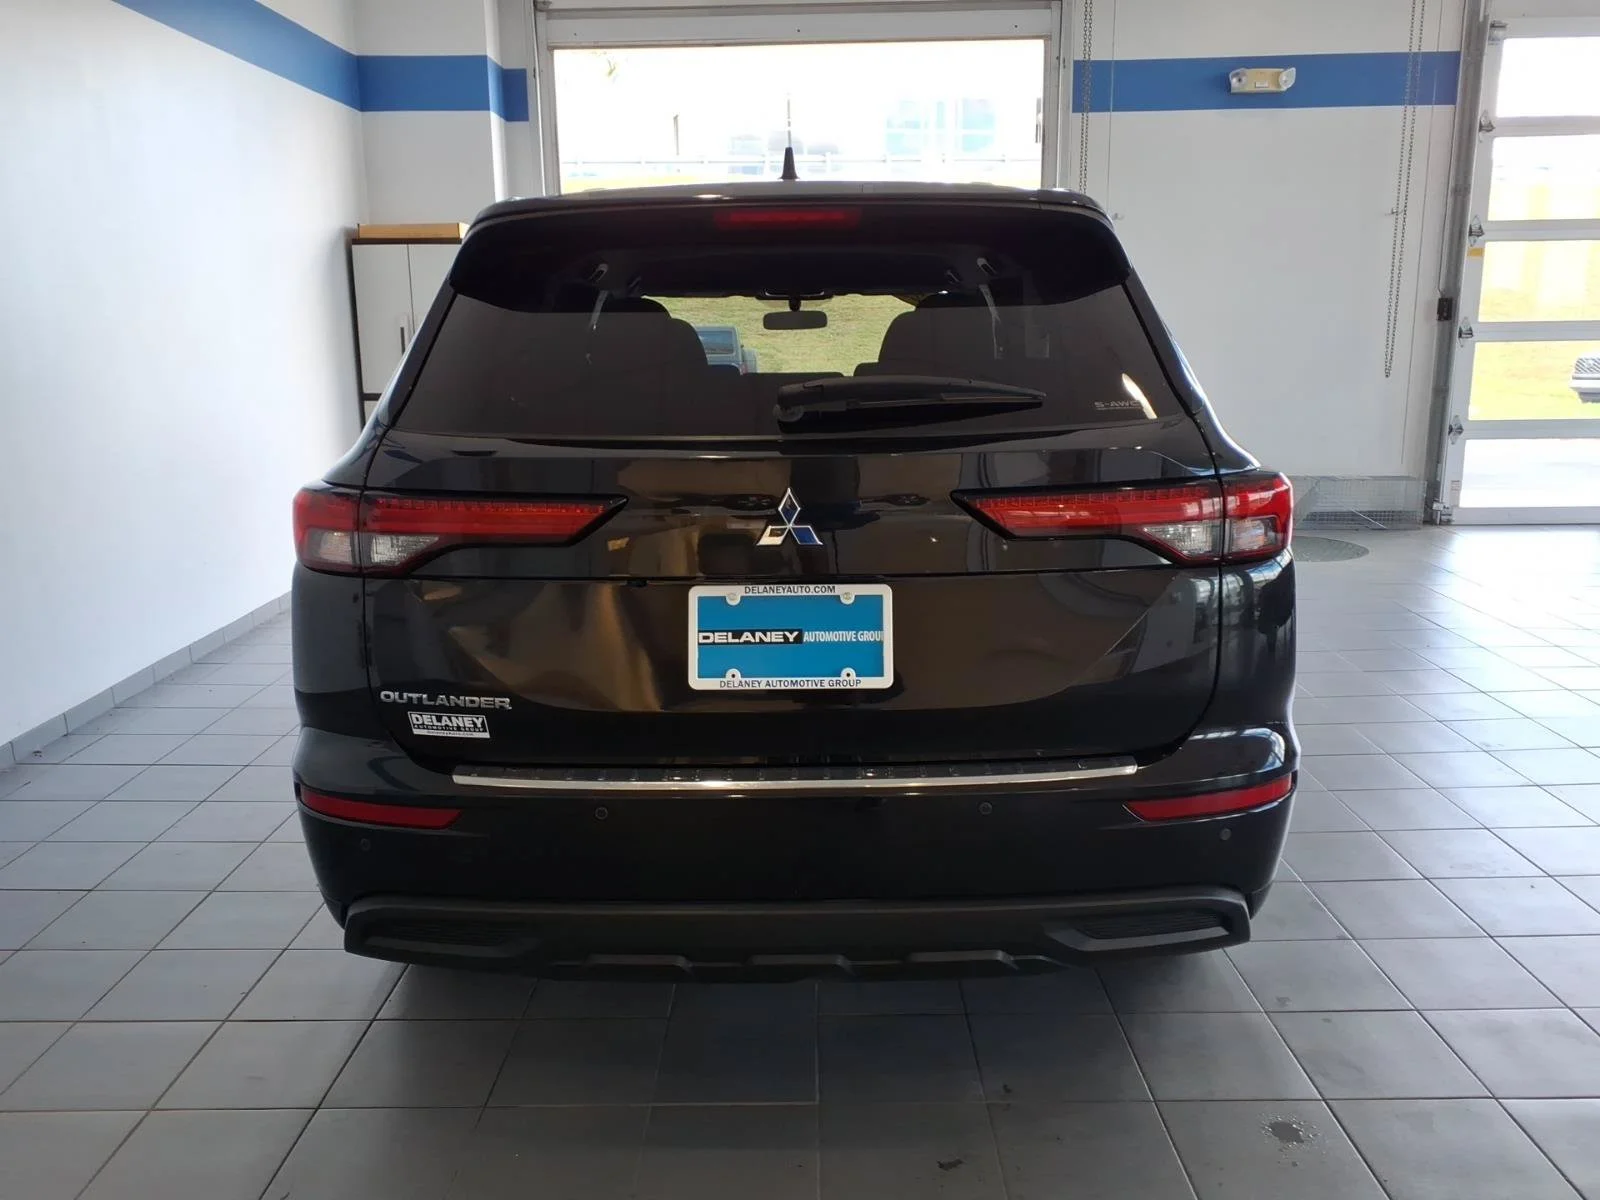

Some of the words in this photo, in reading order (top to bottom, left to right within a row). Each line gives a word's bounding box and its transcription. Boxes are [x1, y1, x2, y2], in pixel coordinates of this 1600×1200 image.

[744, 585, 836, 594] DELANEYAUTO.COM
[699, 631, 799, 643] DELANEY
[803, 630, 857, 642] AUTOMOTIVE
[719, 680, 762, 688] DELANEY
[765, 679, 825, 688] AUTOMOTIVE
[828, 679, 862, 688] GROUP
[380, 690, 512, 709] OUTLANDER
[411, 713, 483, 728] DELANEY
